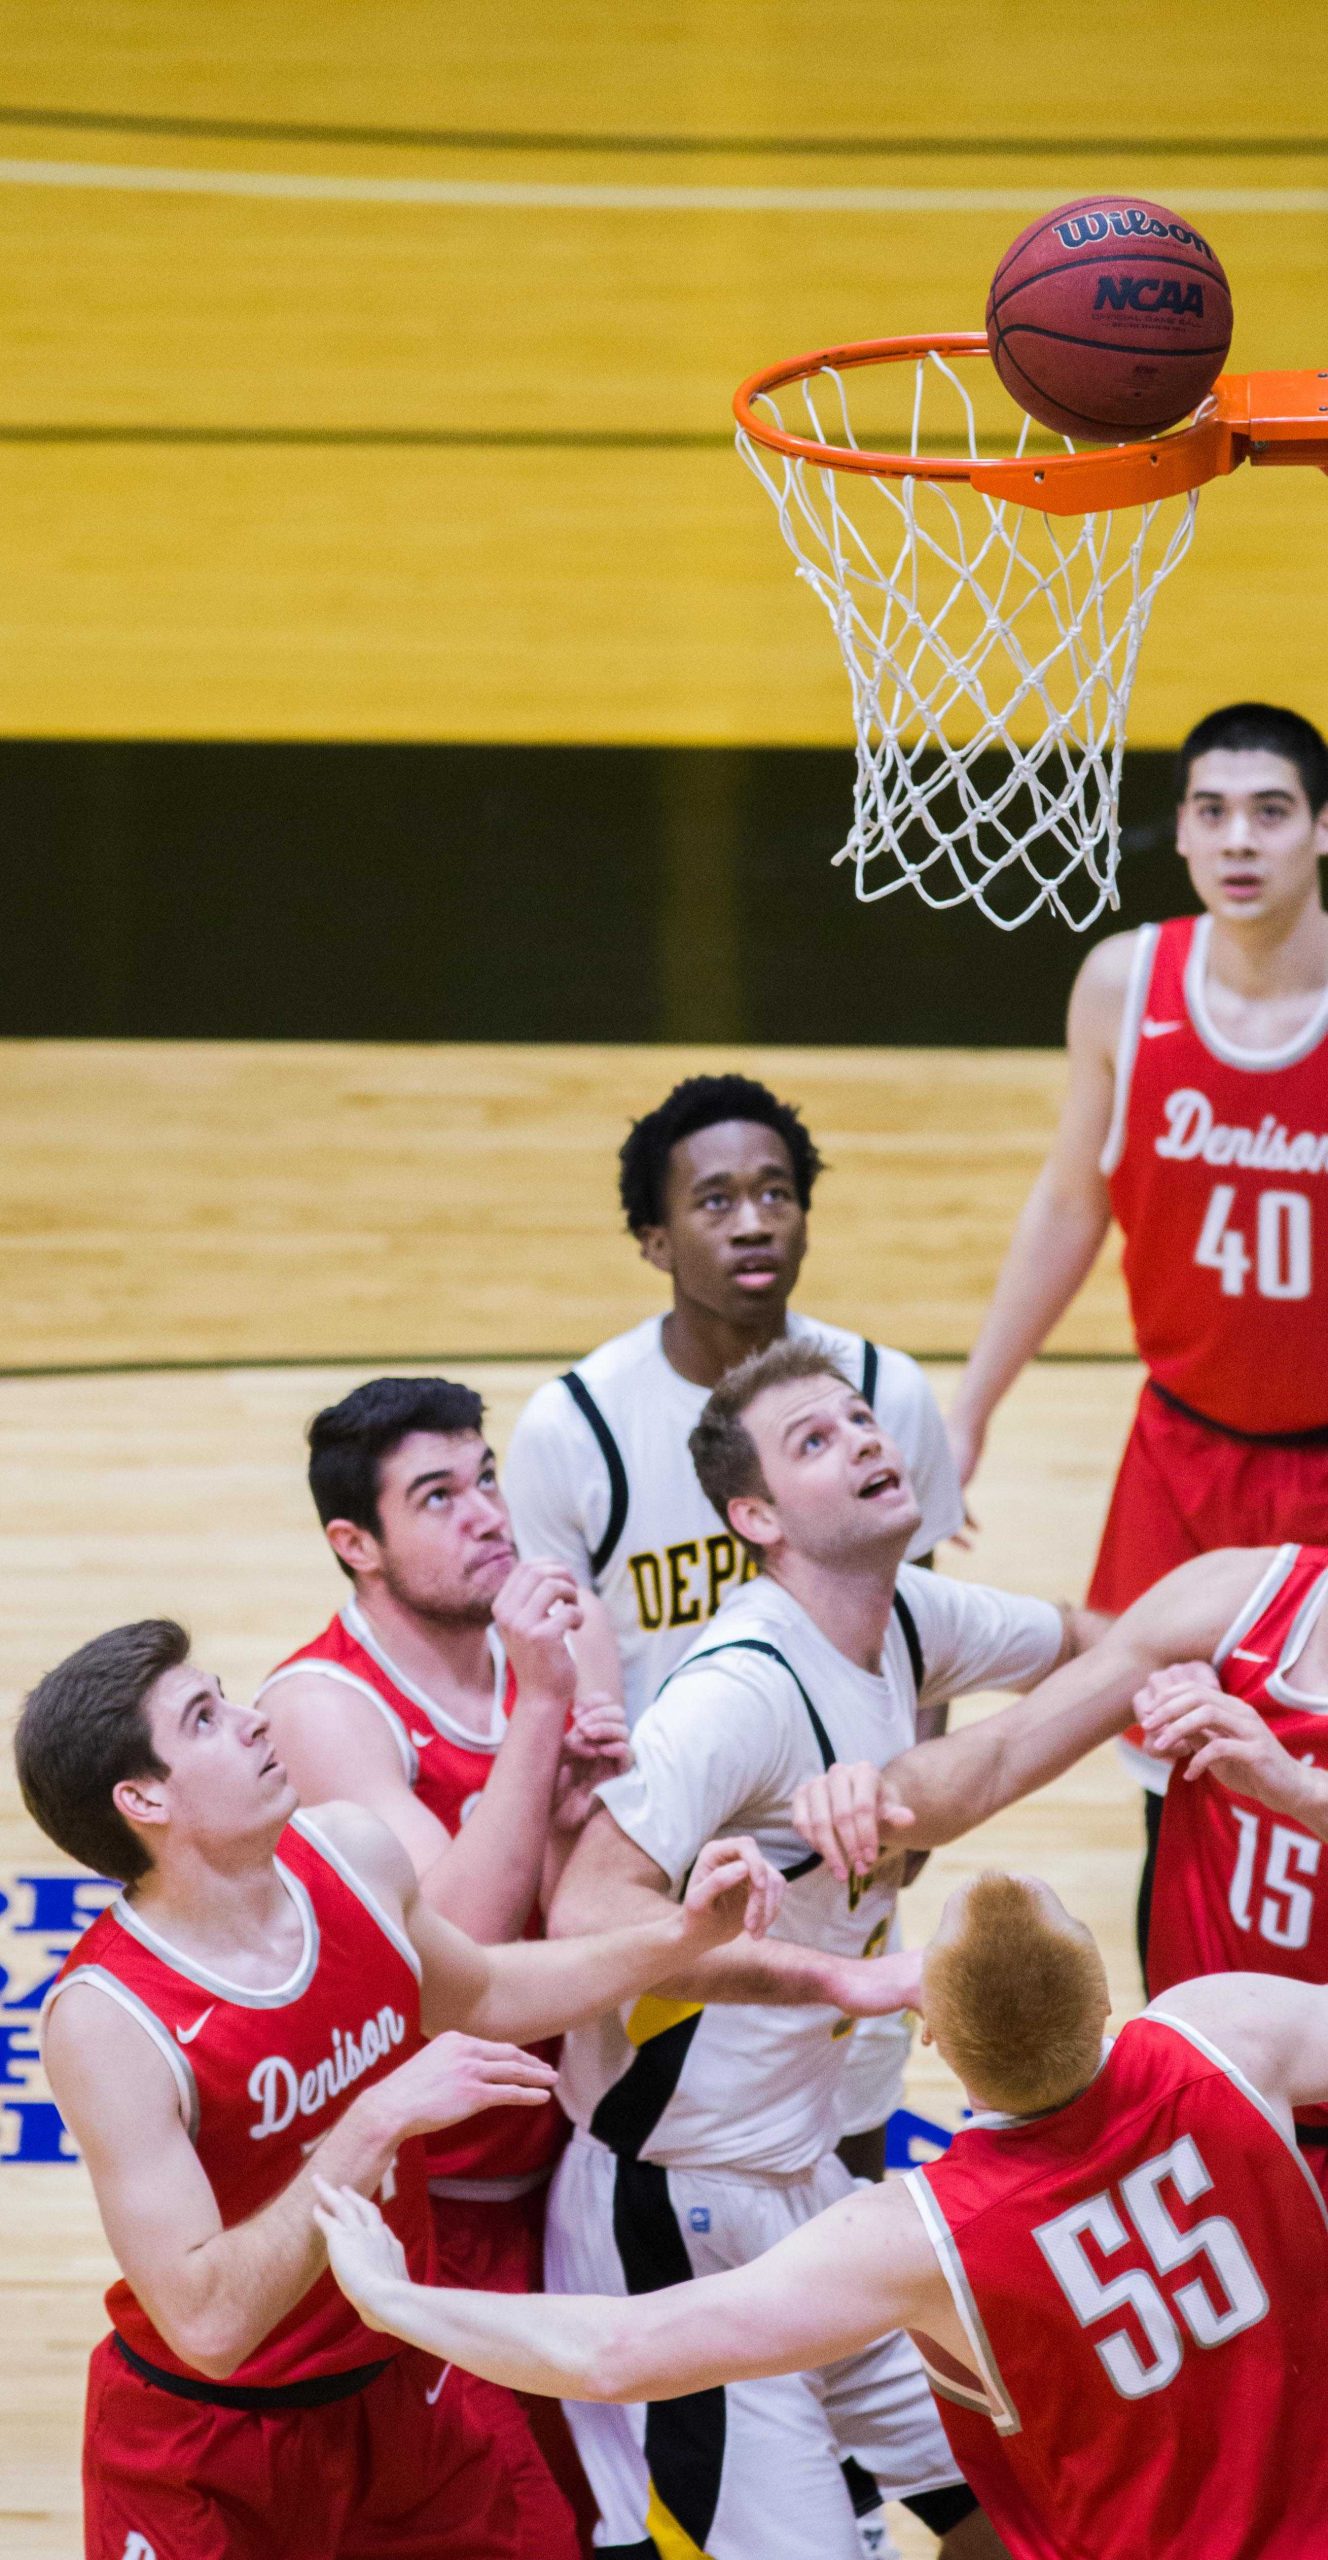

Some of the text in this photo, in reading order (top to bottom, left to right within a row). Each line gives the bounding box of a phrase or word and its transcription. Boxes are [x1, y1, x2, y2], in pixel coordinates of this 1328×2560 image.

[1053, 208, 1214, 262] Wilson
[1092, 275, 1204, 319] NCAA
[1194, 1183, 1311, 1301] 40
[627, 1533, 761, 1633] DEP
[1228, 1804, 1322, 1949] 15
[247, 2004, 406, 2141] Denison
[1030, 2132, 1271, 2401] 55
